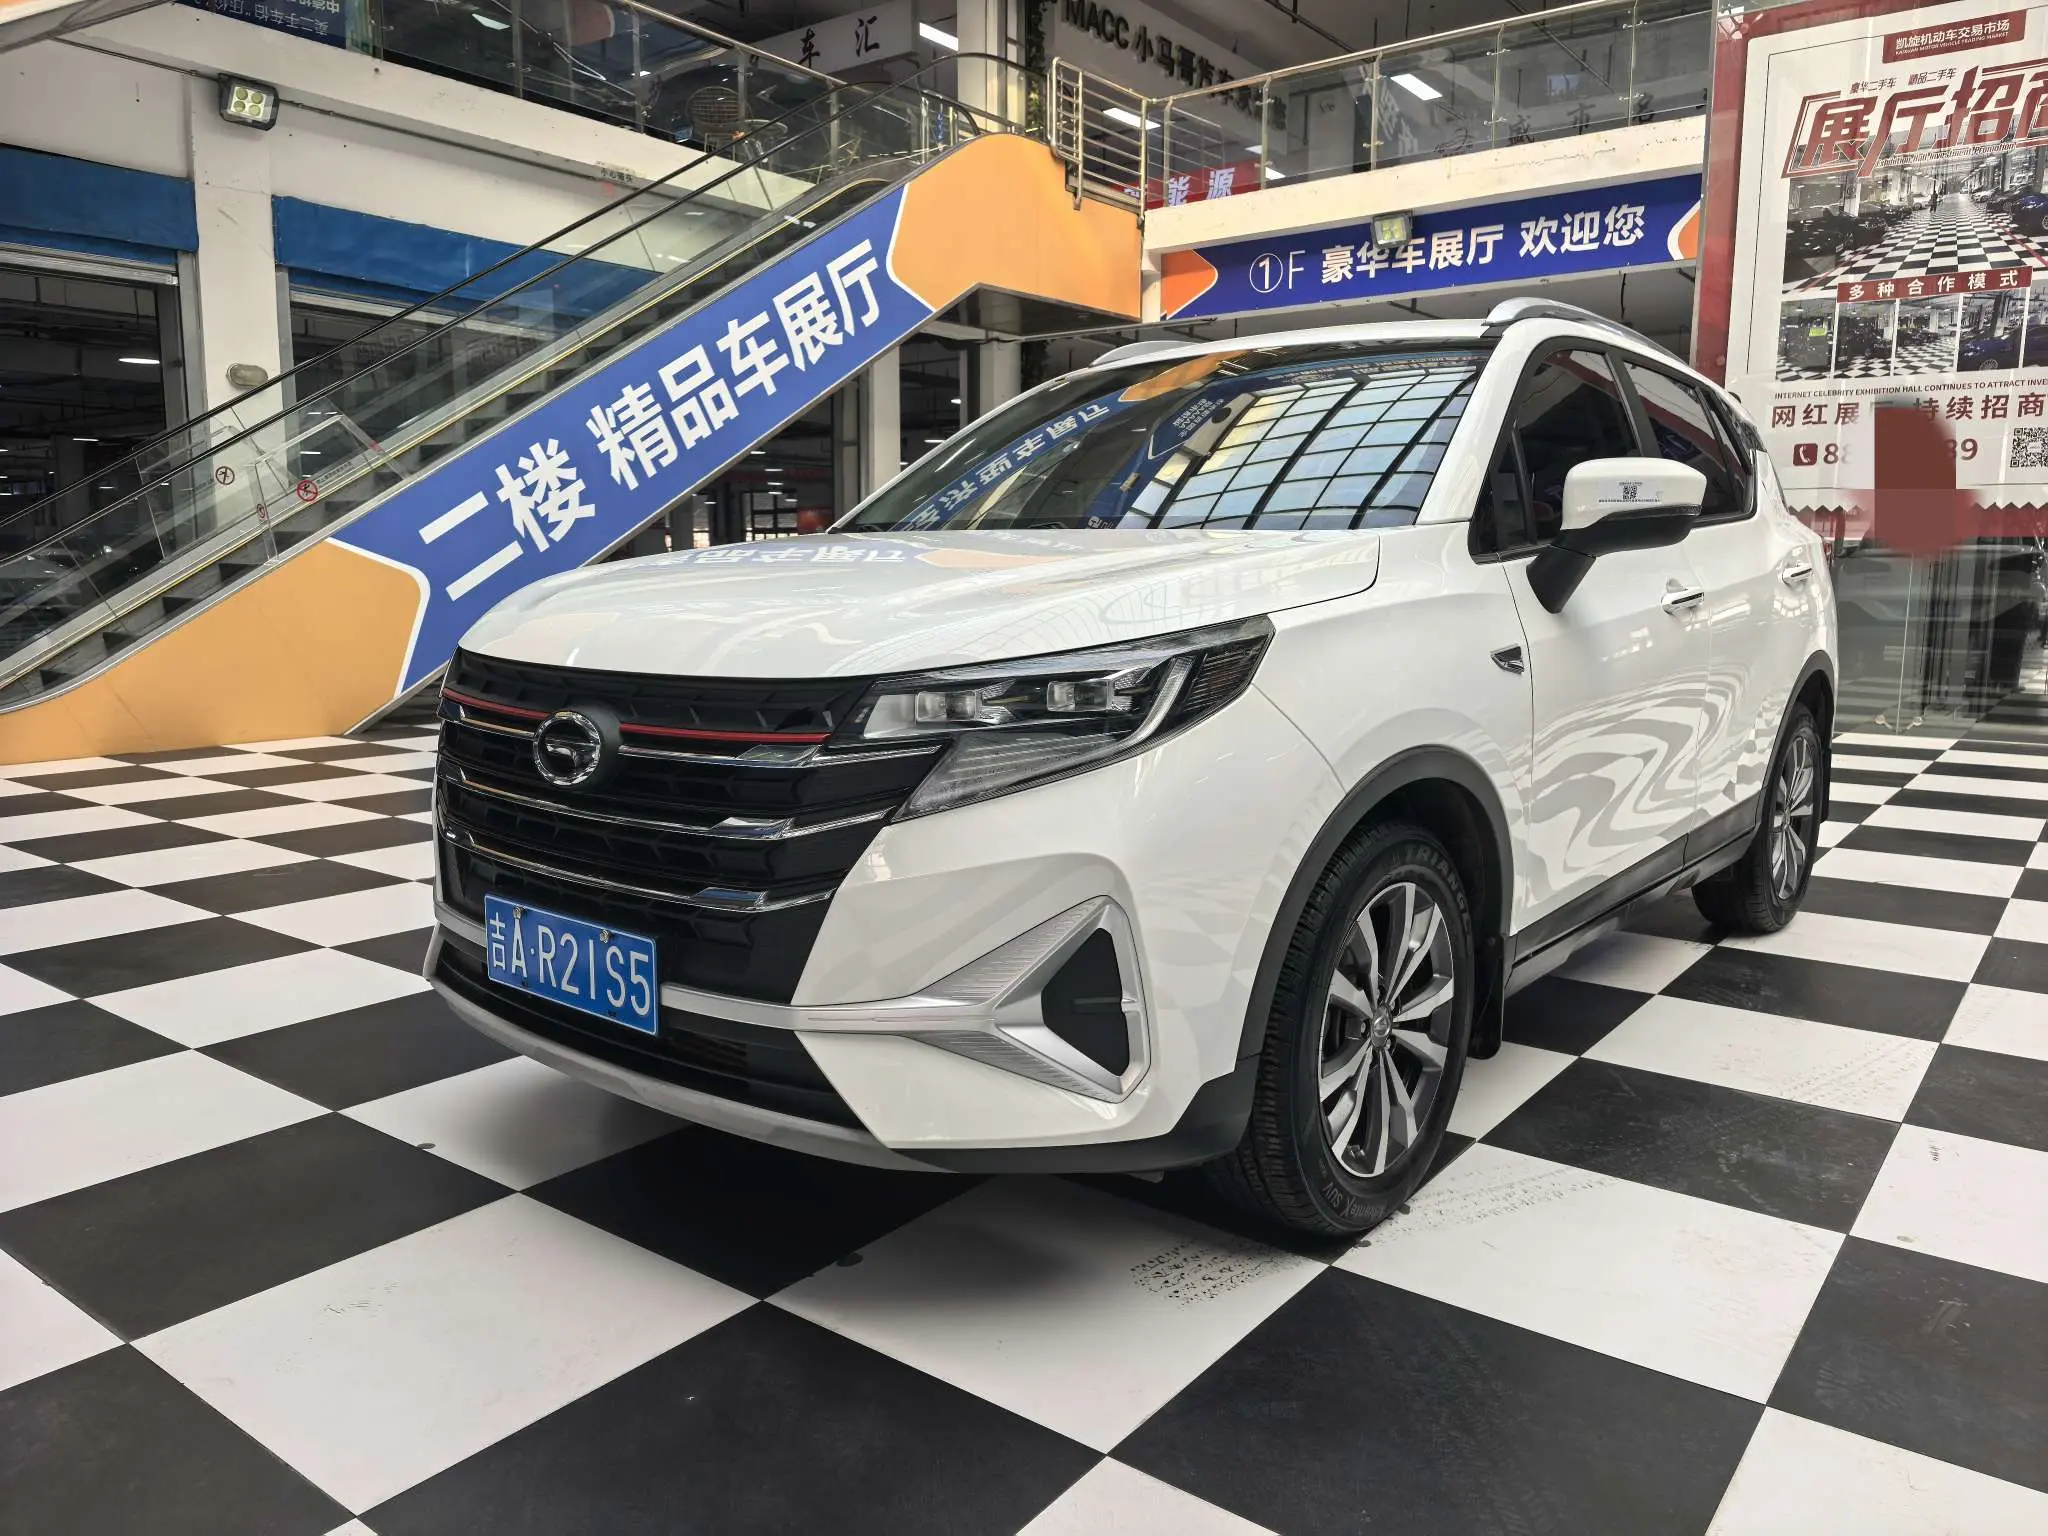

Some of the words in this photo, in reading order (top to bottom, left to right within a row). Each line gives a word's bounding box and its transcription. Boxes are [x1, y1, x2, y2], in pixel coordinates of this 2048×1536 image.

[1895, 19, 2010, 50] 凯旋机动车交易市场
[1320, 222, 1504, 285] 豪华车展厅
[1519, 203, 1646, 259] 欢迎您
[1849, 268, 2019, 300] 多种合作模式
[1774, 390, 1811, 400] INTERNET
[1813, 388, 1854, 398] CELEBRITY
[1855, 386, 1901, 396] EXHIBITION
[1902, 384, 1923, 393] HALL
[1924, 382, 1972, 392] CONTINUES
[1973, 381, 1986, 389] TO
[1986, 379, 2025, 389] ATTRACT
[418, 437, 597, 602] 二楼
[585, 238, 881, 492] 精品车展厅
[1771, 401, 1894, 429] 网红展
